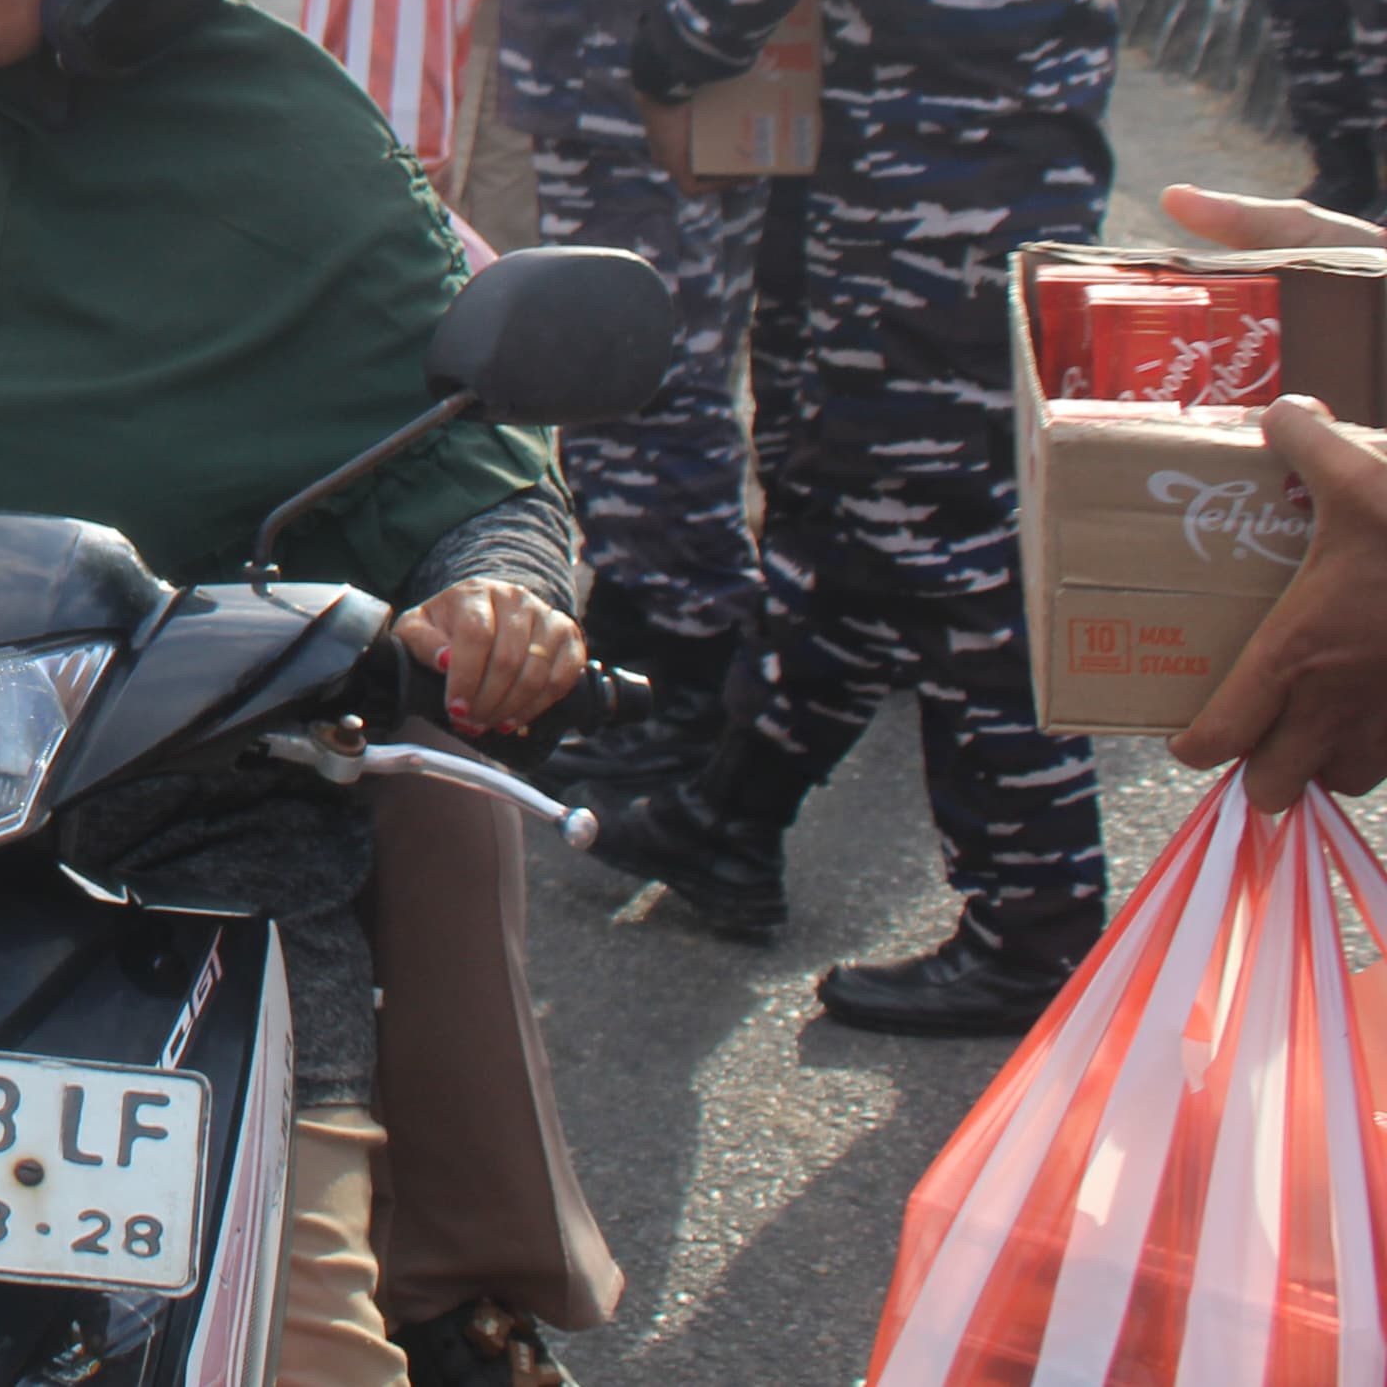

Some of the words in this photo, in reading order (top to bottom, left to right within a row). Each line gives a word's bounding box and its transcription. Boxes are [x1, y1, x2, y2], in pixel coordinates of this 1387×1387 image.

[1147, 470, 1315, 566] Tehbo
[1083, 625, 1117, 655] 10
[1138, 654, 1212, 678] STACKS
[61, 1084, 172, 1167] LF
